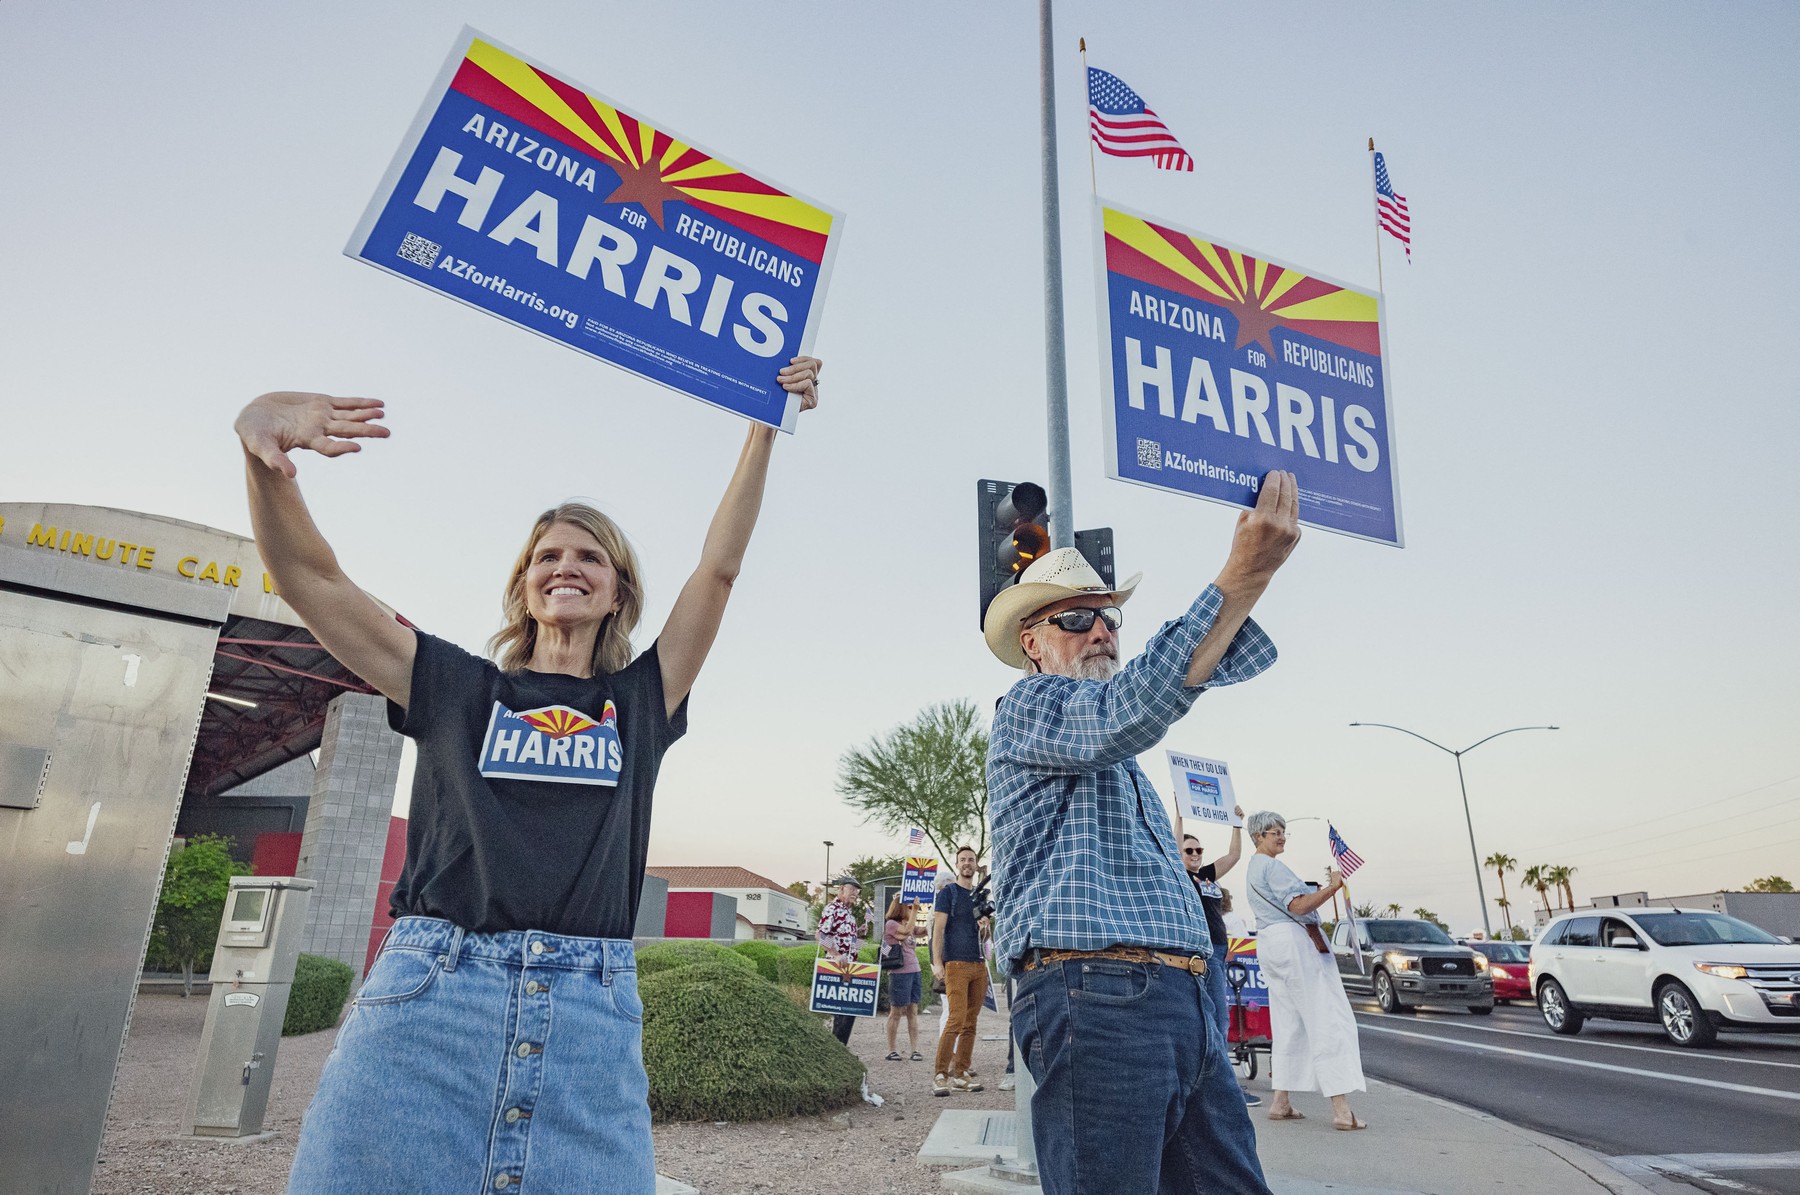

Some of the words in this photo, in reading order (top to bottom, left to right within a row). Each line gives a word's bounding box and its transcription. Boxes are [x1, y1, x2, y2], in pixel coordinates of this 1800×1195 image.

[463, 114, 596, 192] ARIZONA
[413, 147, 793, 359] HARRIS
[620, 207, 647, 230] FOR
[676, 214, 803, 287] REPUBLICANS
[438, 255, 578, 328] AZforHarris.org
[1130, 291, 1226, 343] ARIZONA
[1247, 349, 1267, 369] FOR
[1283, 339, 1374, 388] REPUBLICANS
[1125, 336, 1380, 473] HARRIS
[1164, 450, 1258, 493] AZforHarris.org
[26, 523, 156, 569] MINUTE
[177, 556, 242, 587] CAR
[490, 729, 623, 773] HARRIS
[1171, 755, 1189, 768] WHEN
[1189, 759, 1205, 771] THEY
[1206, 762, 1214, 774] GO
[1215, 765, 1228, 775] LOW
[1191, 805, 1201, 817] WE
[1203, 808, 1211, 818] GO
[1212, 810, 1229, 821] HIGH
[904, 879, 935, 893] HARRIS
[815, 984, 874, 1004] HARRIS
